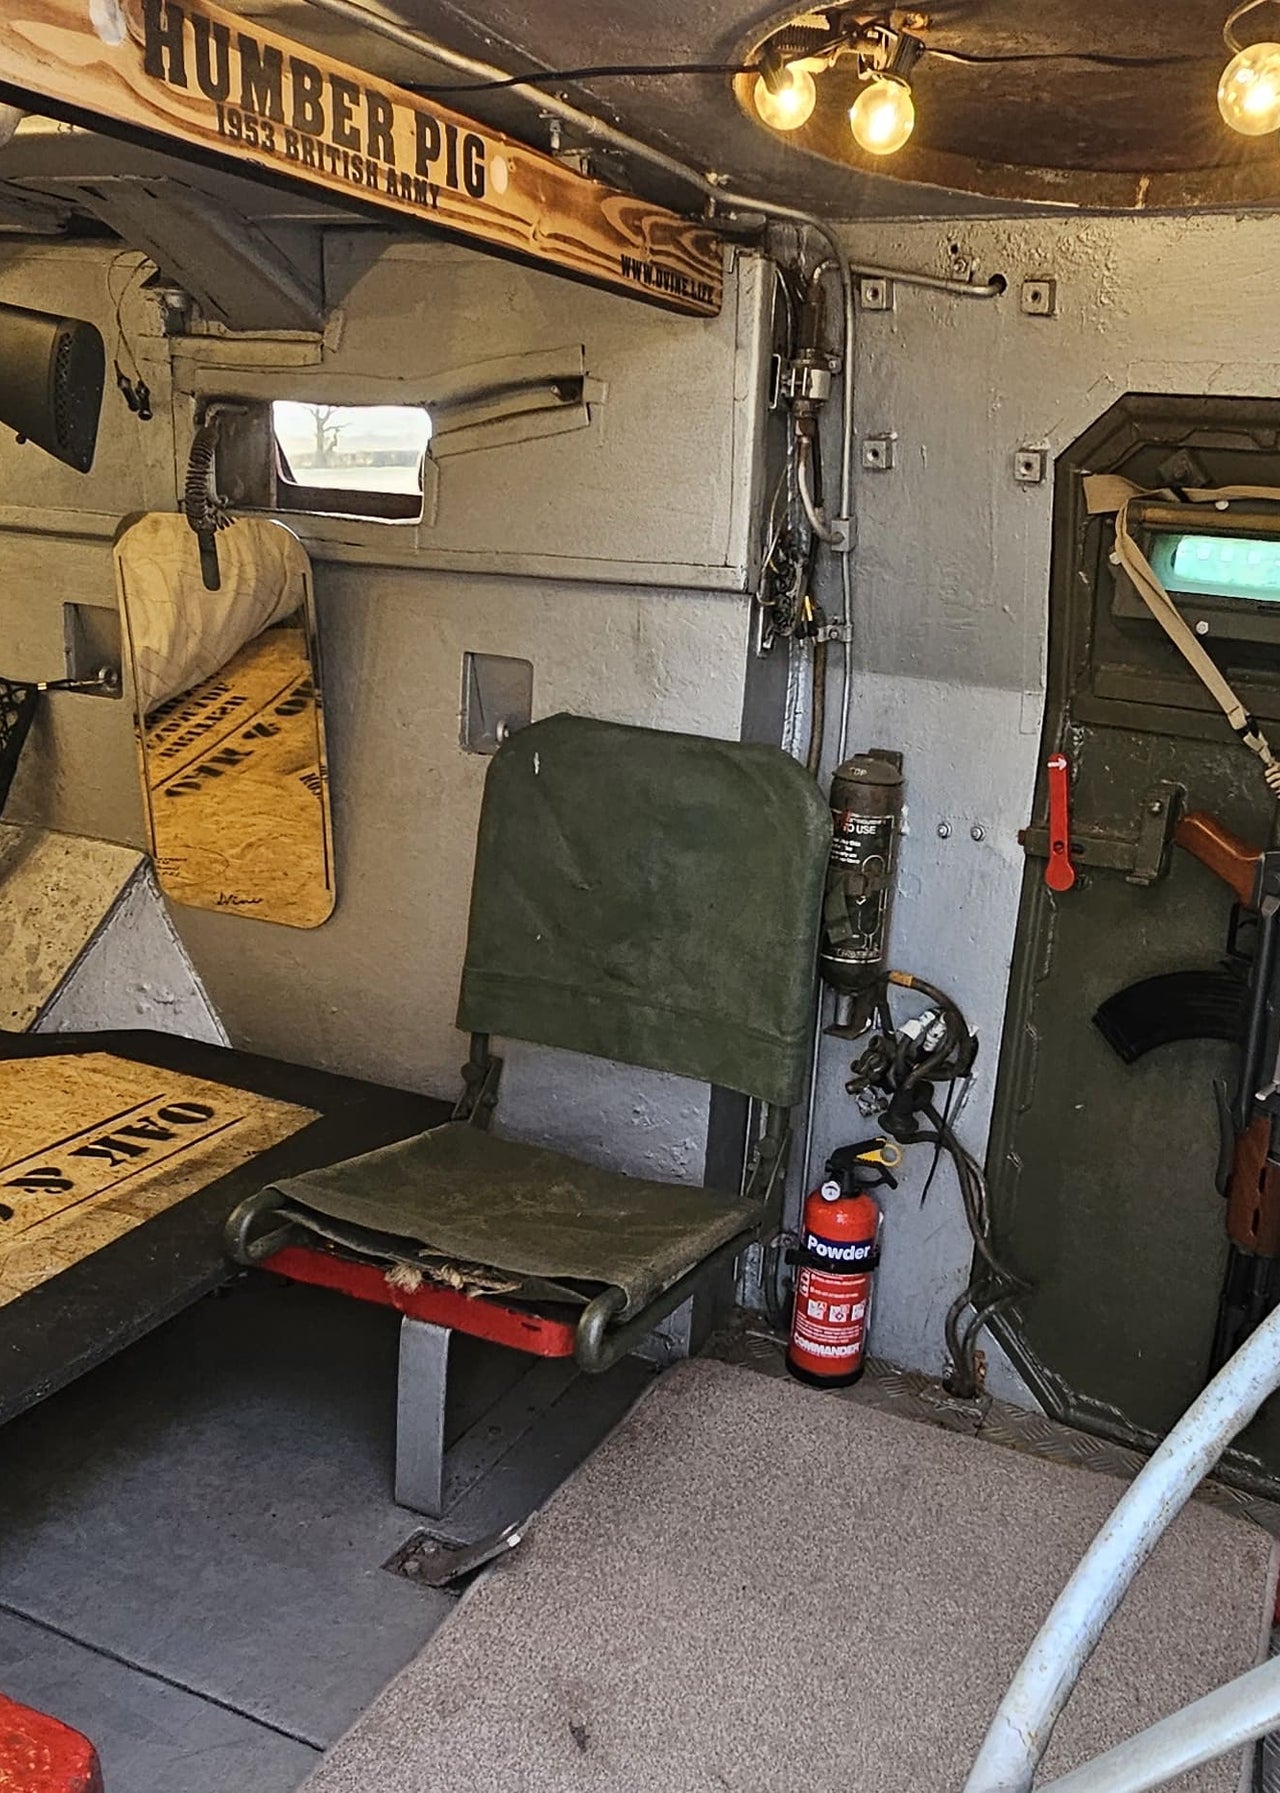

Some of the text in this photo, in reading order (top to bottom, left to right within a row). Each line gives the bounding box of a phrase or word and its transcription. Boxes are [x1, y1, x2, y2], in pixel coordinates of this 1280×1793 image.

[142, 0, 485, 199] HUMBER PIG
[216, 102, 440, 210] 1953 BRITISH ARMY
[856, 825, 877, 835] USE
[67, 1102, 216, 1168] OAK
[2, 1166, 75, 1195] &
[806, 1234, 870, 1261] Powder
[794, 1331, 860, 1356] COMMANDER
